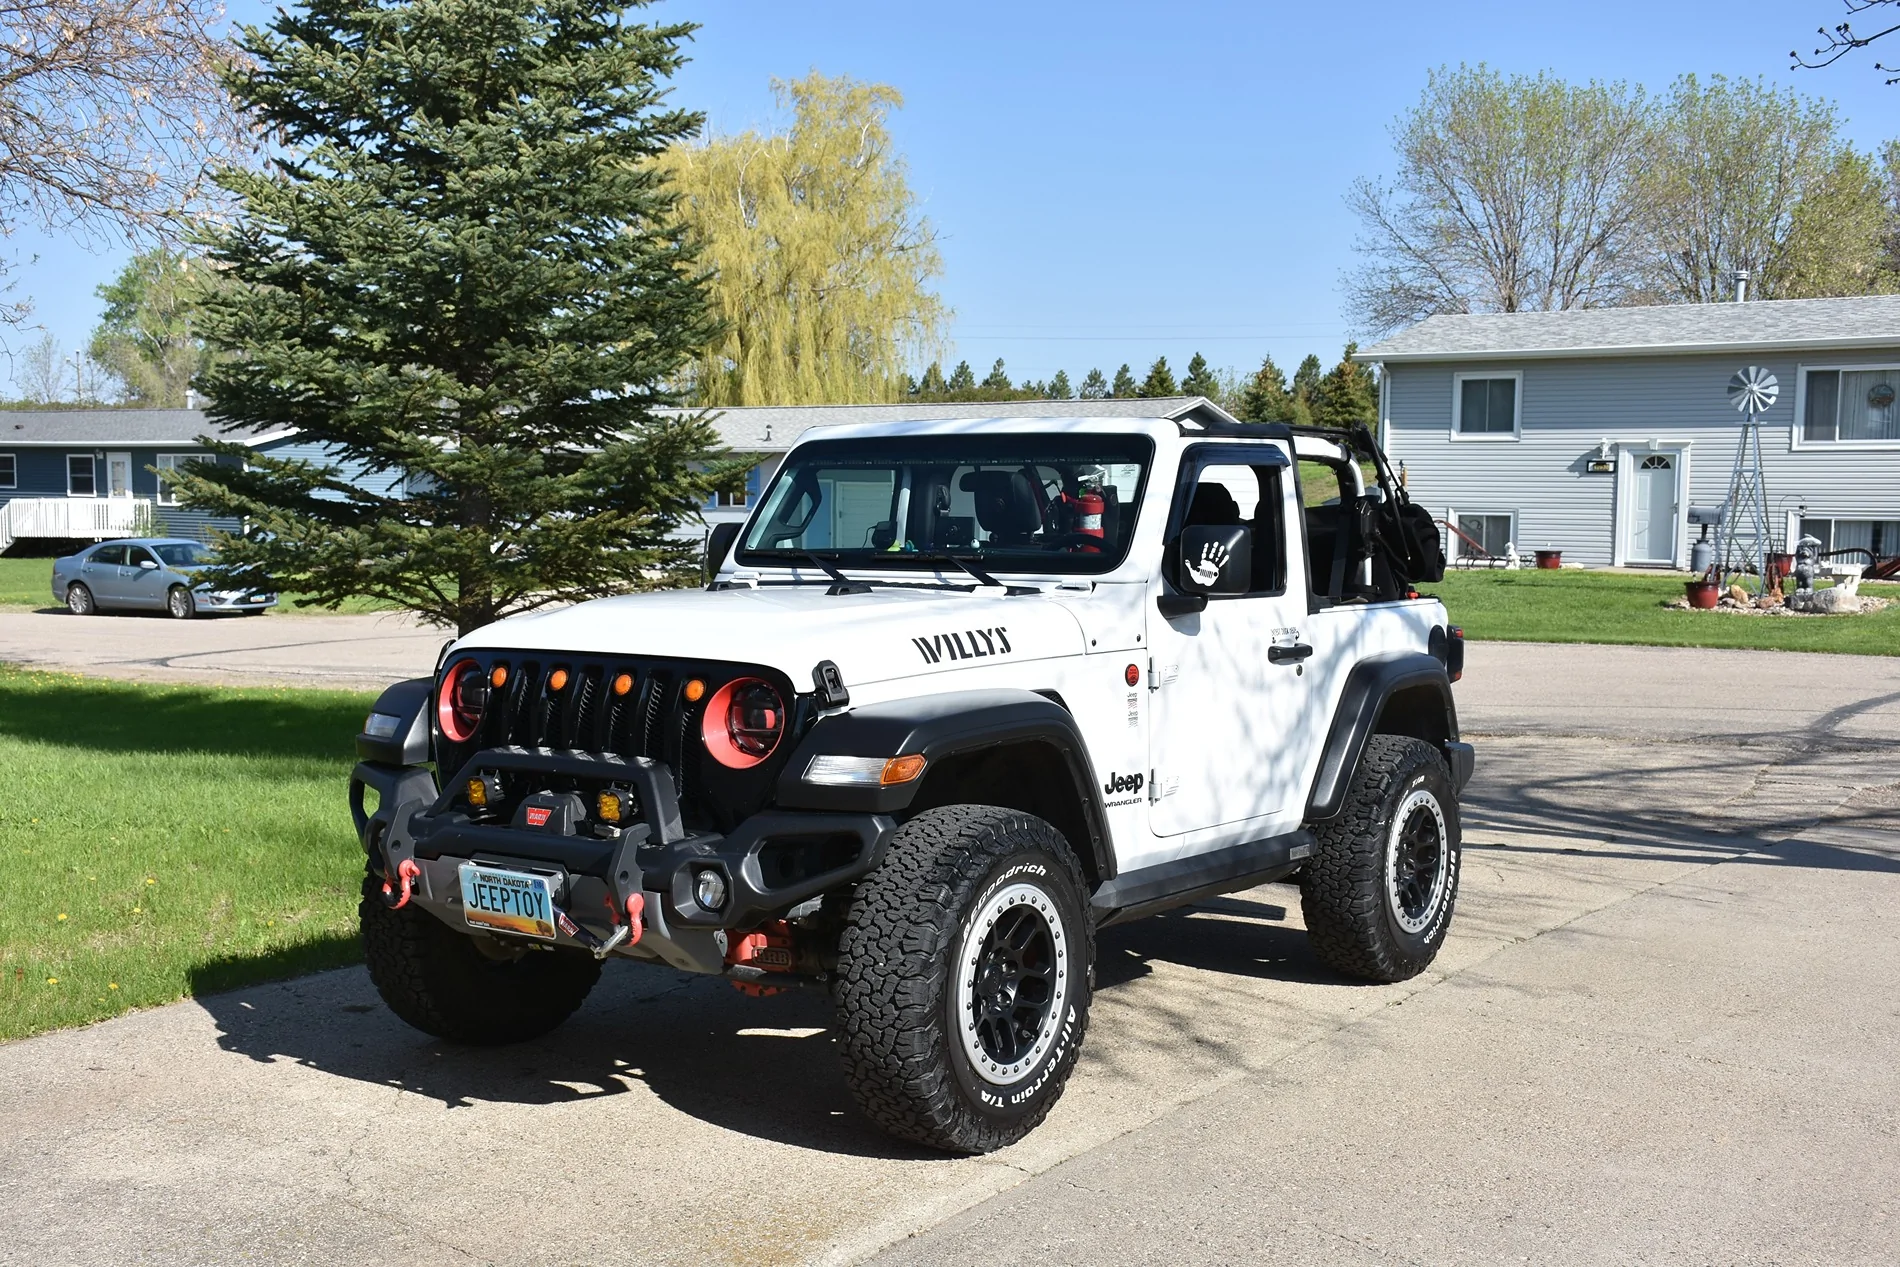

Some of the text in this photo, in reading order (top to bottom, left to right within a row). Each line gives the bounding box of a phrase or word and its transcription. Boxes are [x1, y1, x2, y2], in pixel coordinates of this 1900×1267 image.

[911, 627, 1011, 664] WILLYS
[1105, 772, 1144, 794] Jeep
[1104, 798, 1142, 808] WRANGLER
[480, 874, 501, 886] NORTH
[504, 878, 530, 889] DAKOTA
[1424, 850, 1456, 944] BFGoodrich
[469, 882, 543, 920] JEEPTOY
[981, 1004, 1076, 1108] All-Terrain T/A
